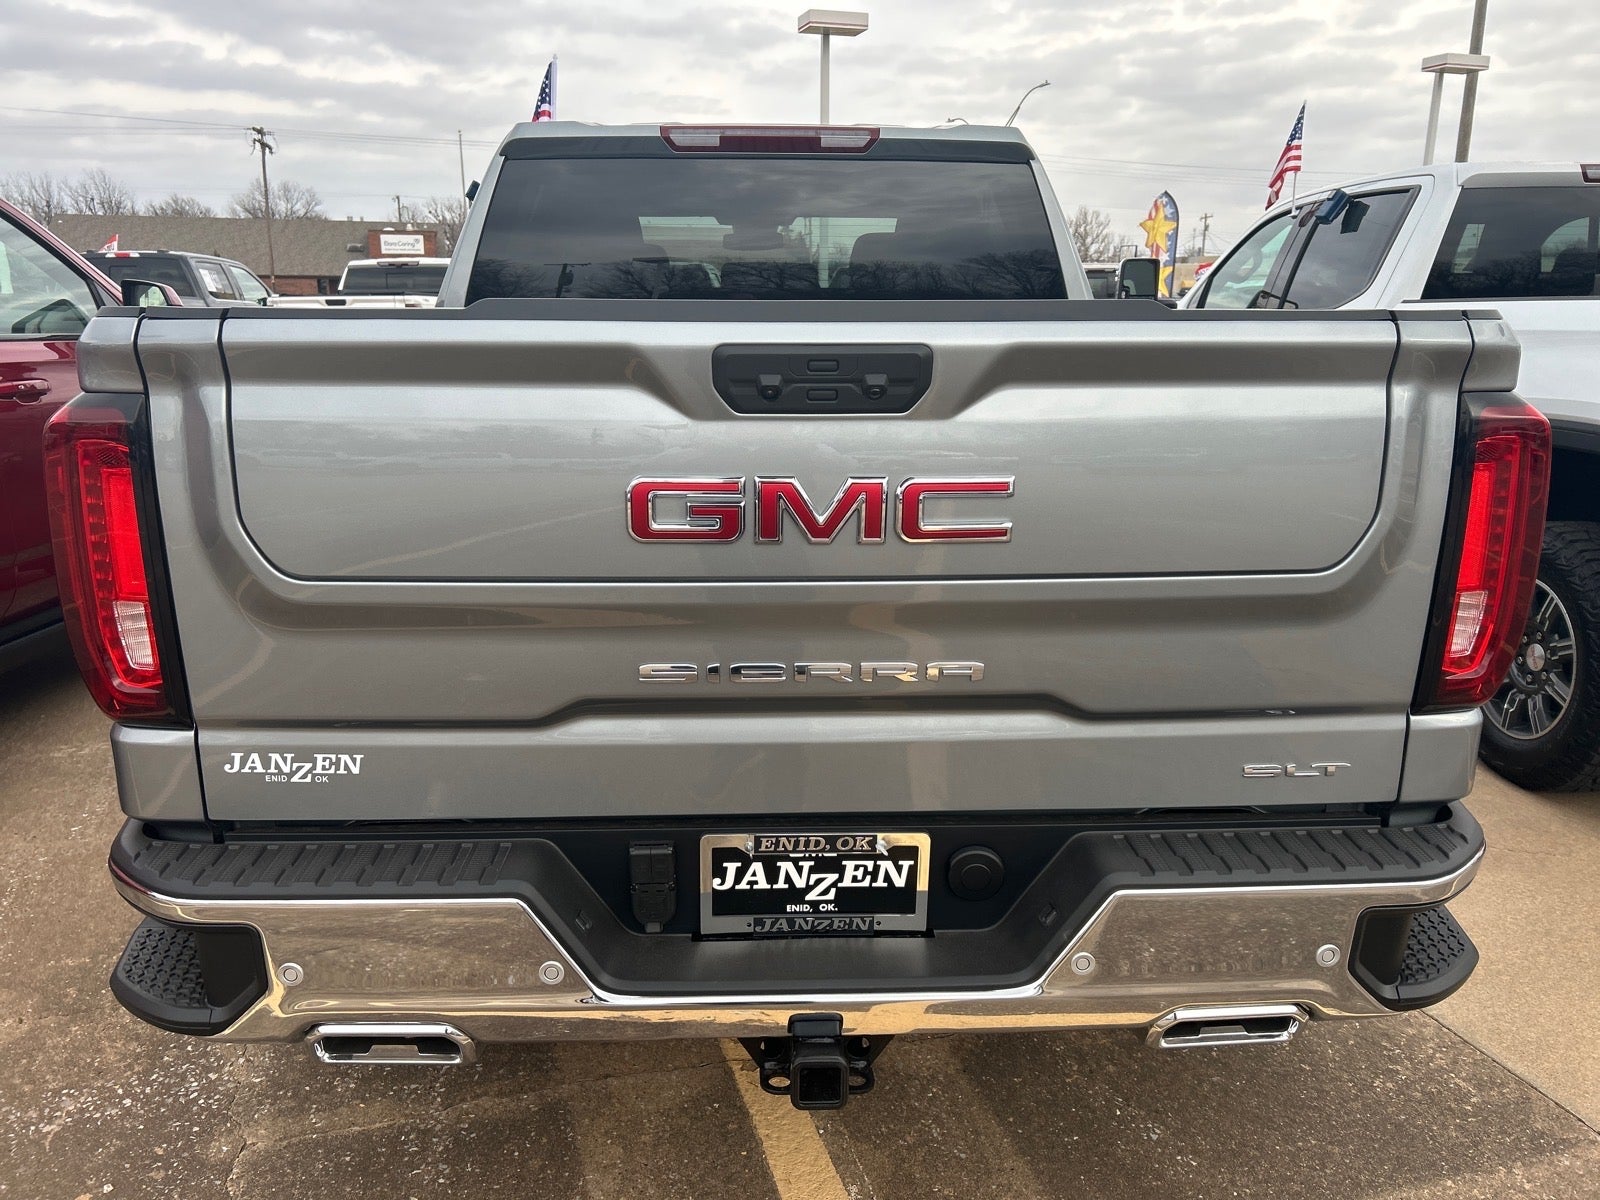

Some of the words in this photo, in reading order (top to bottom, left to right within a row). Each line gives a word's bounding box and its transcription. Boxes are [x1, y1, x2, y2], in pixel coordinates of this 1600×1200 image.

[626, 475, 1016, 544] GMC
[638, 662, 985, 683] SIERRA
[224, 752, 364, 783] JANZEN
[1242, 763, 1351, 777] SLT
[315, 775, 329, 783] OK
[758, 837, 831, 851] ENID,
[836, 836, 873, 851] OK
[712, 860, 914, 900] JANZEN
[786, 904, 813, 912] ENID,
[818, 903, 838, 911] OK.
[755, 917, 873, 932] JANZEN
